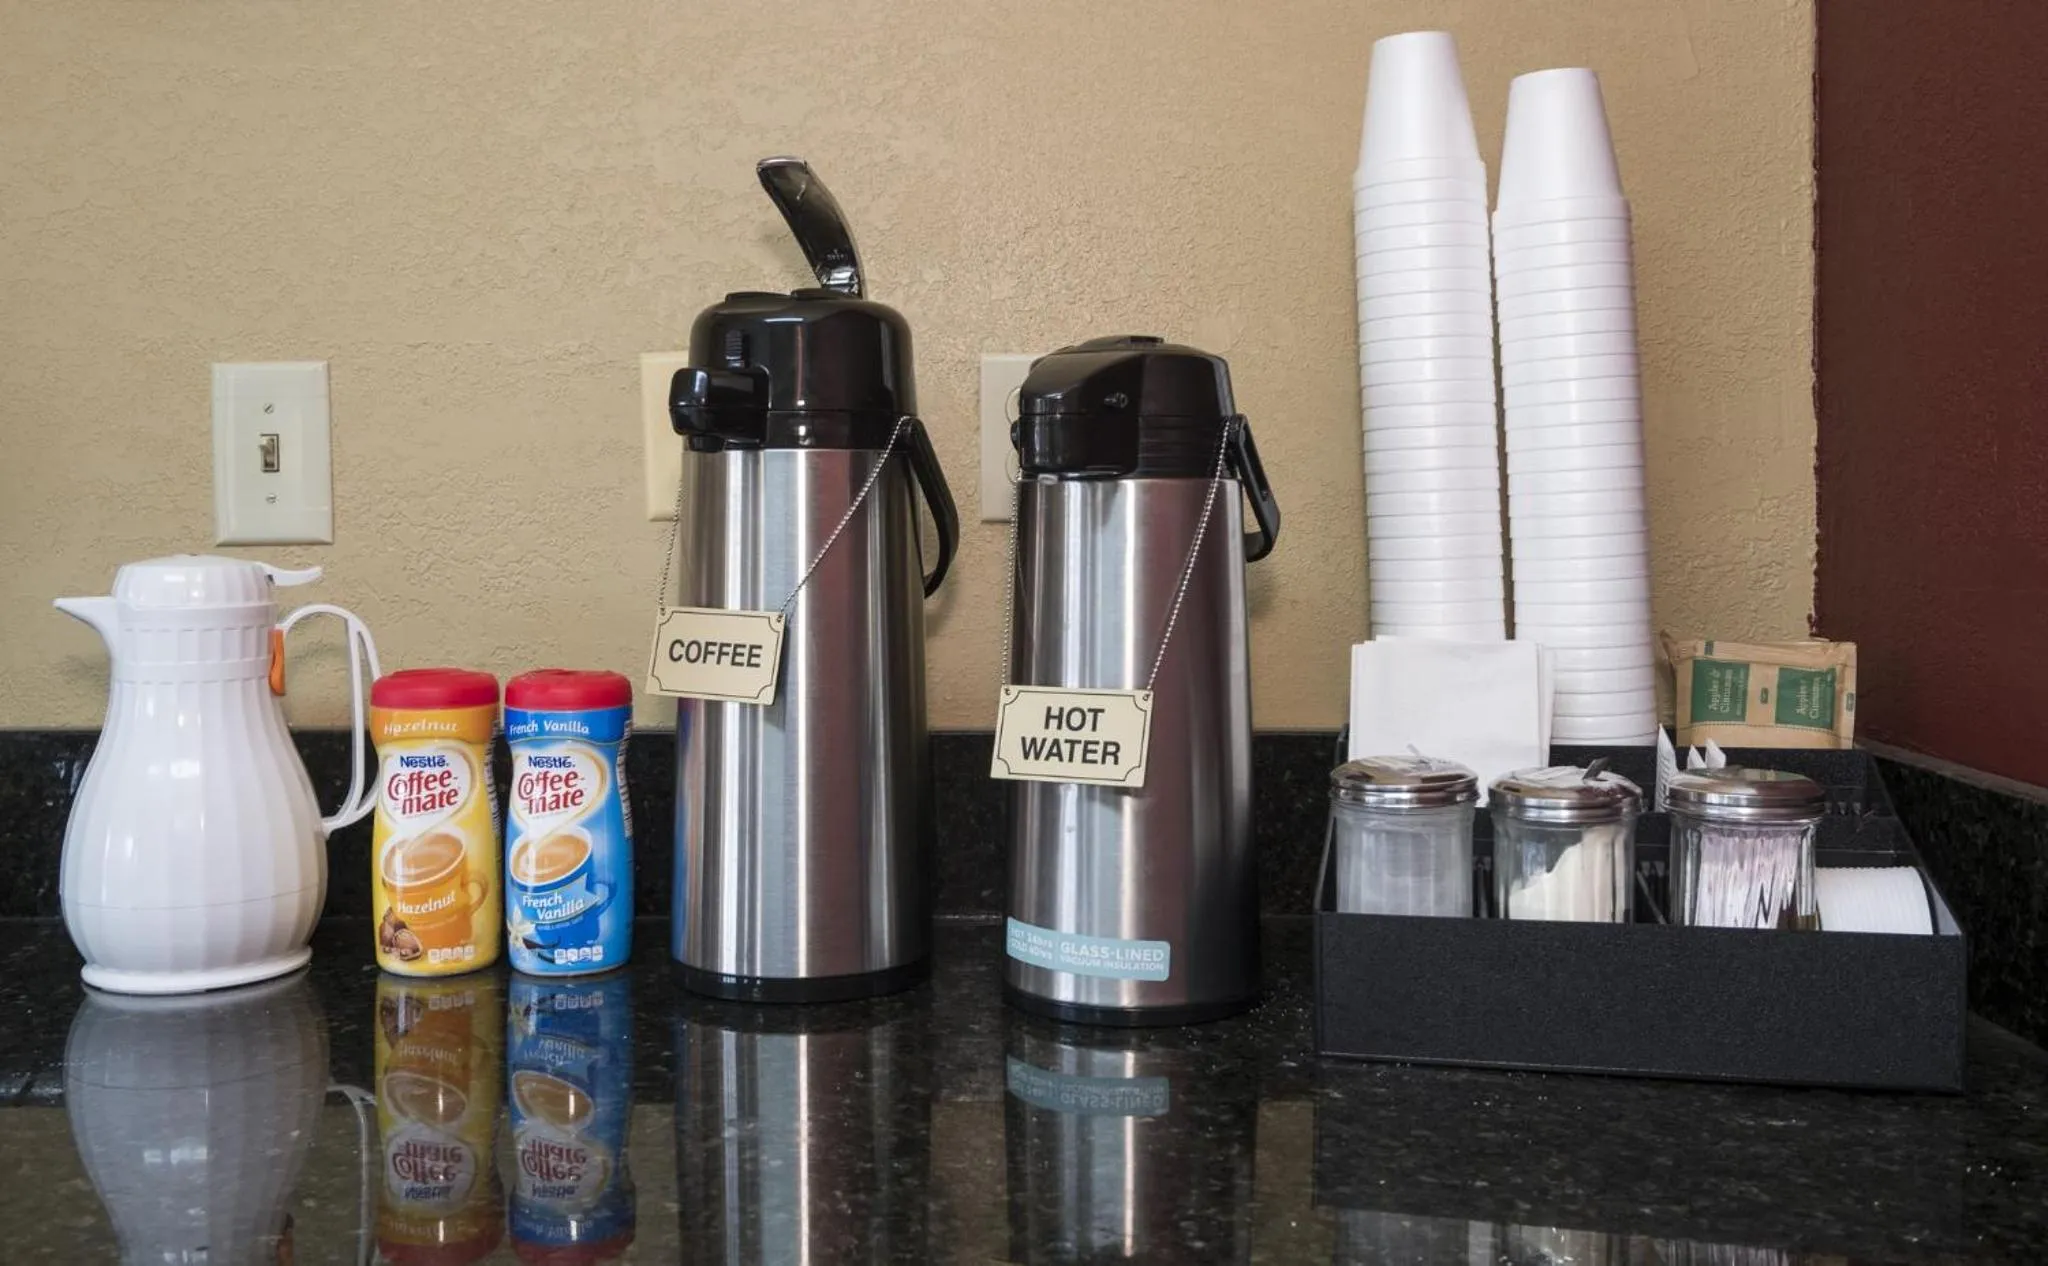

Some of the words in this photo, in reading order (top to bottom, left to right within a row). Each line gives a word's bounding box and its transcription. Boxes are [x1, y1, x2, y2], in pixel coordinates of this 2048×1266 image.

[669, 639, 763, 668] COFFEE
[384, 719, 458, 736] Hazelnut
[509, 720, 538, 736] French
[543, 720, 590, 734] Vanilla
[1044, 706, 1105, 732] HOT
[1020, 736, 1121, 766] WATER
[402, 788, 459, 815] mate
[528, 788, 584, 814] mate
[397, 890, 457, 913] Hazelnut
[522, 892, 562, 907] French
[536, 898, 584, 920] Vanilla
[1103, 960, 1164, 972] INSULATION
